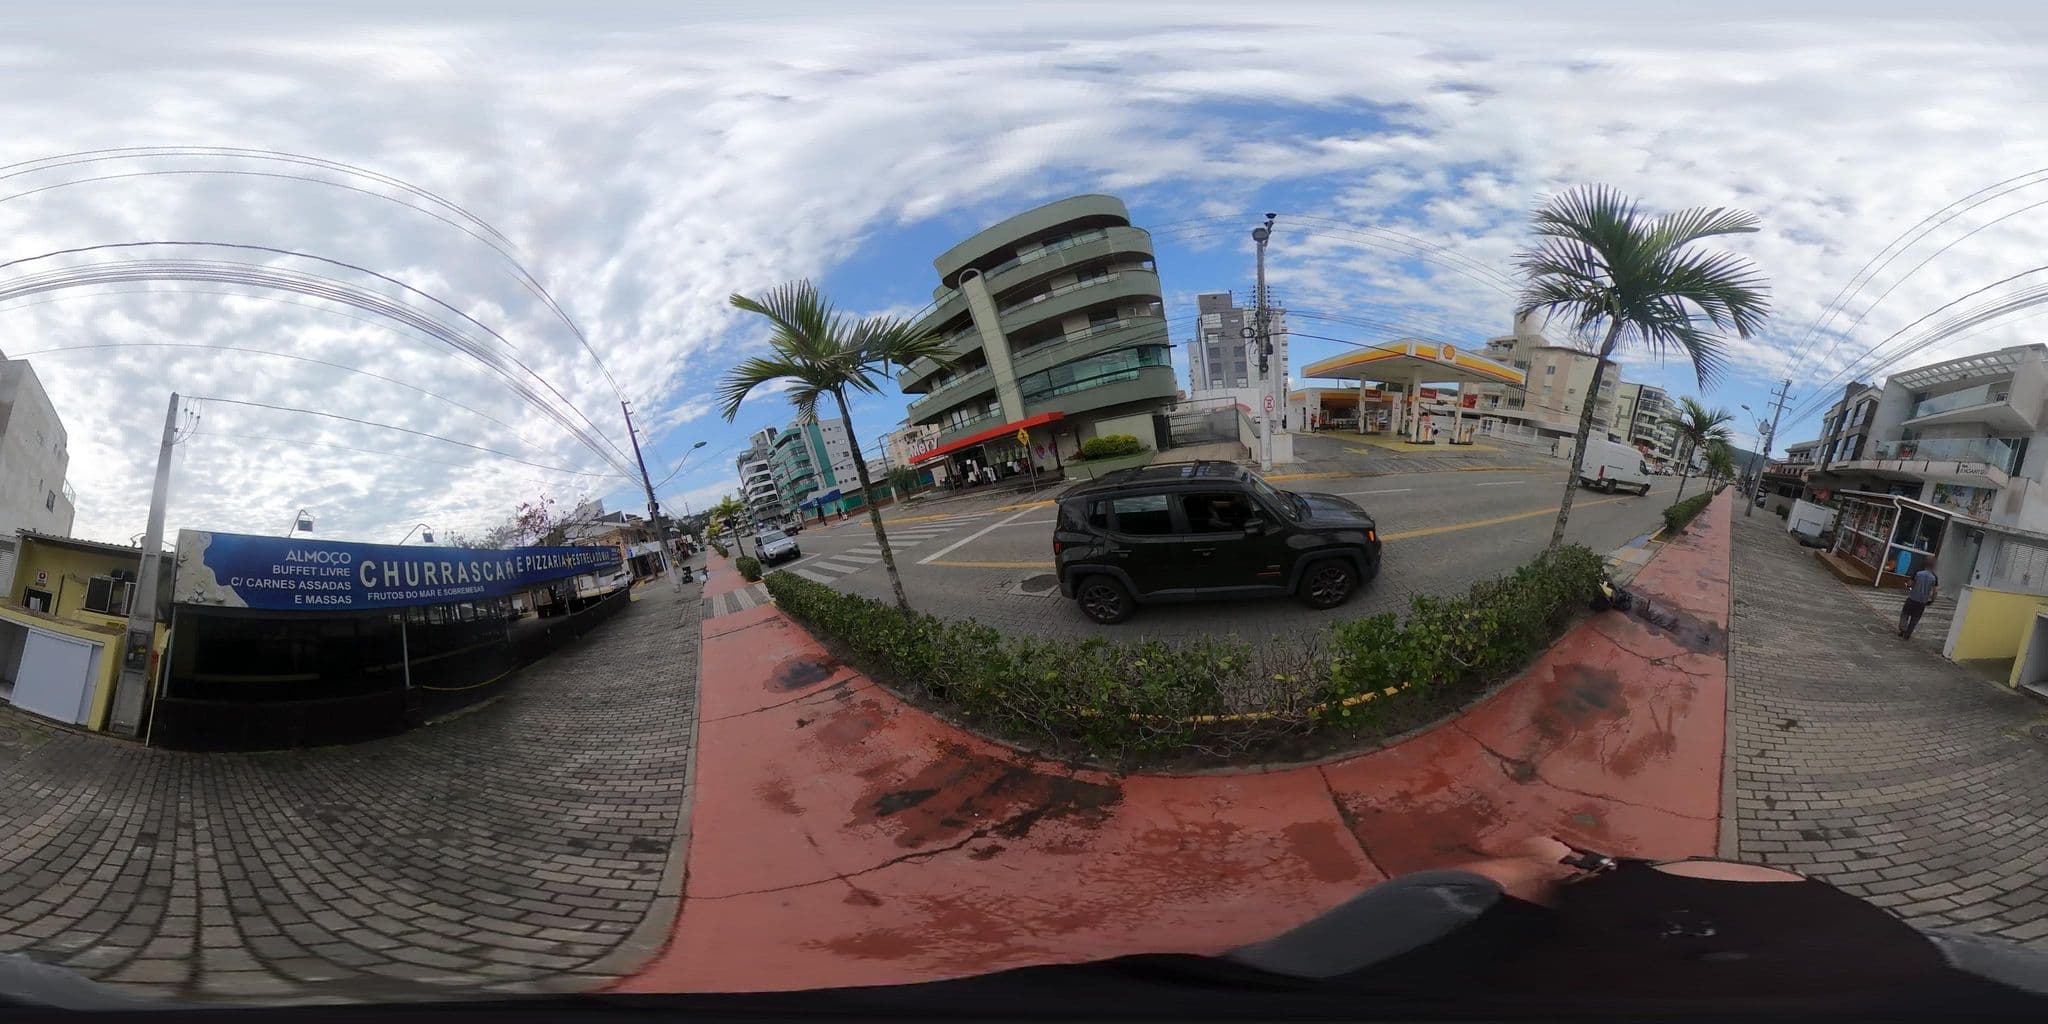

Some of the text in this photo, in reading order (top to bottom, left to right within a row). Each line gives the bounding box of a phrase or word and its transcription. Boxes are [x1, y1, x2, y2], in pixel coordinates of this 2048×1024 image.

[285, 550, 352, 565] ALMOÇO
[517, 556, 525, 572] E
[526, 554, 566, 572] PIZZARIA
[272, 564, 351, 577] BUFFET LIVRE
[231, 577, 352, 590] C/ CARNES ASSADAS
[294, 595, 352, 604] E MASSAS
[368, 591, 404, 600] FRUTOS
[406, 590, 418, 599] DO
[419, 589, 436, 598] MAR
[444, 586, 485, 595] SOBREMESAS
